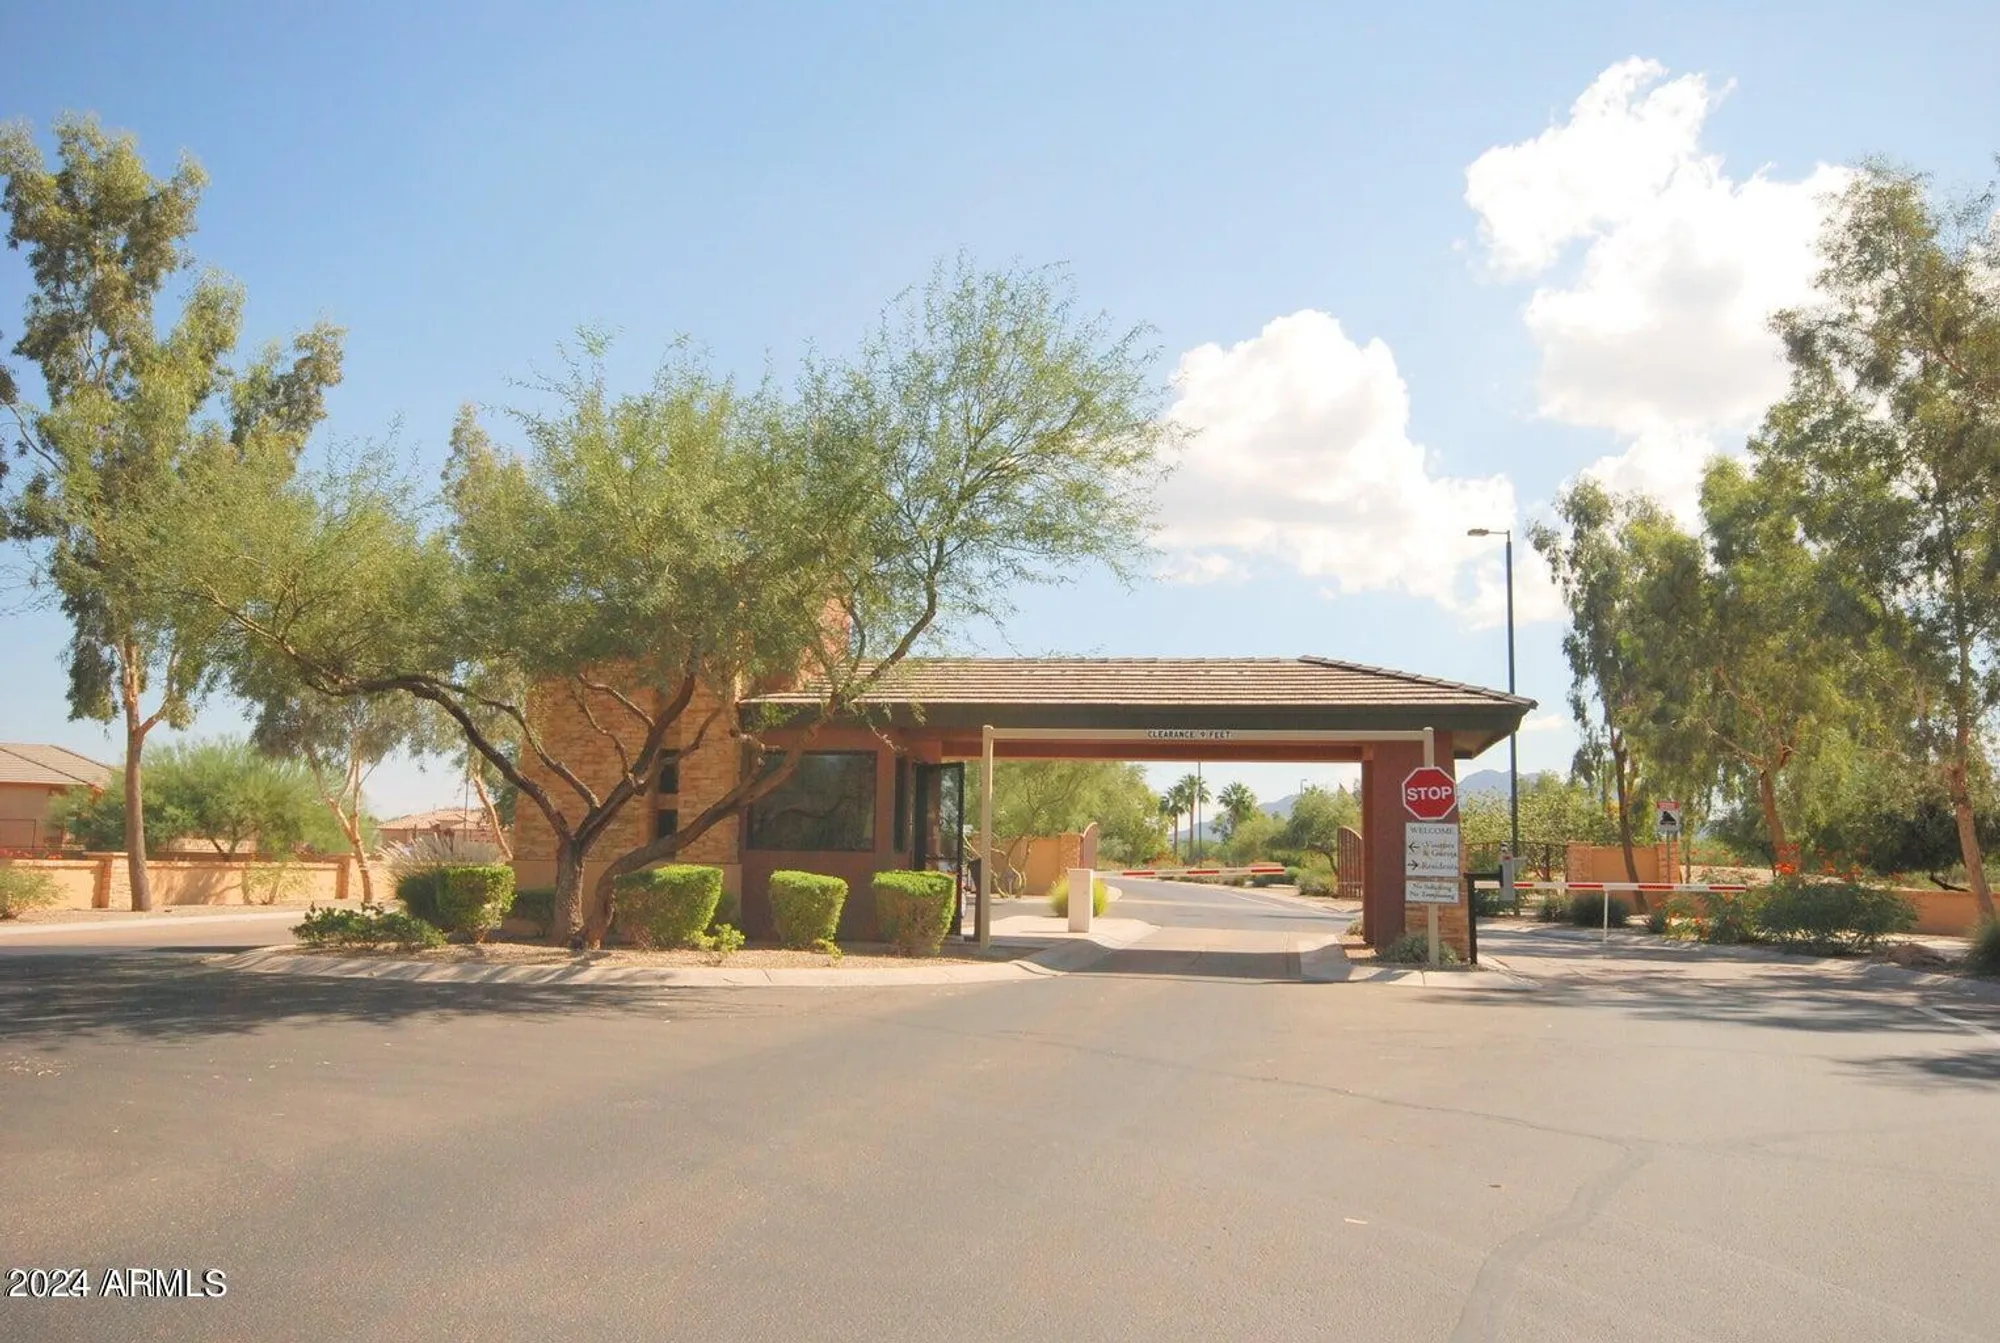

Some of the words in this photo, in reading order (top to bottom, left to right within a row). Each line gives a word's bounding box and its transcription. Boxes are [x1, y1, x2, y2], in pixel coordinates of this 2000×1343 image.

[1147, 730, 1193, 739] CLEARANCE
[1200, 730, 1205, 738] 9
[1209, 731, 1230, 739] FEET
[1407, 786, 1452, 801] STOP
[1410, 827, 1453, 835] WELCOME
